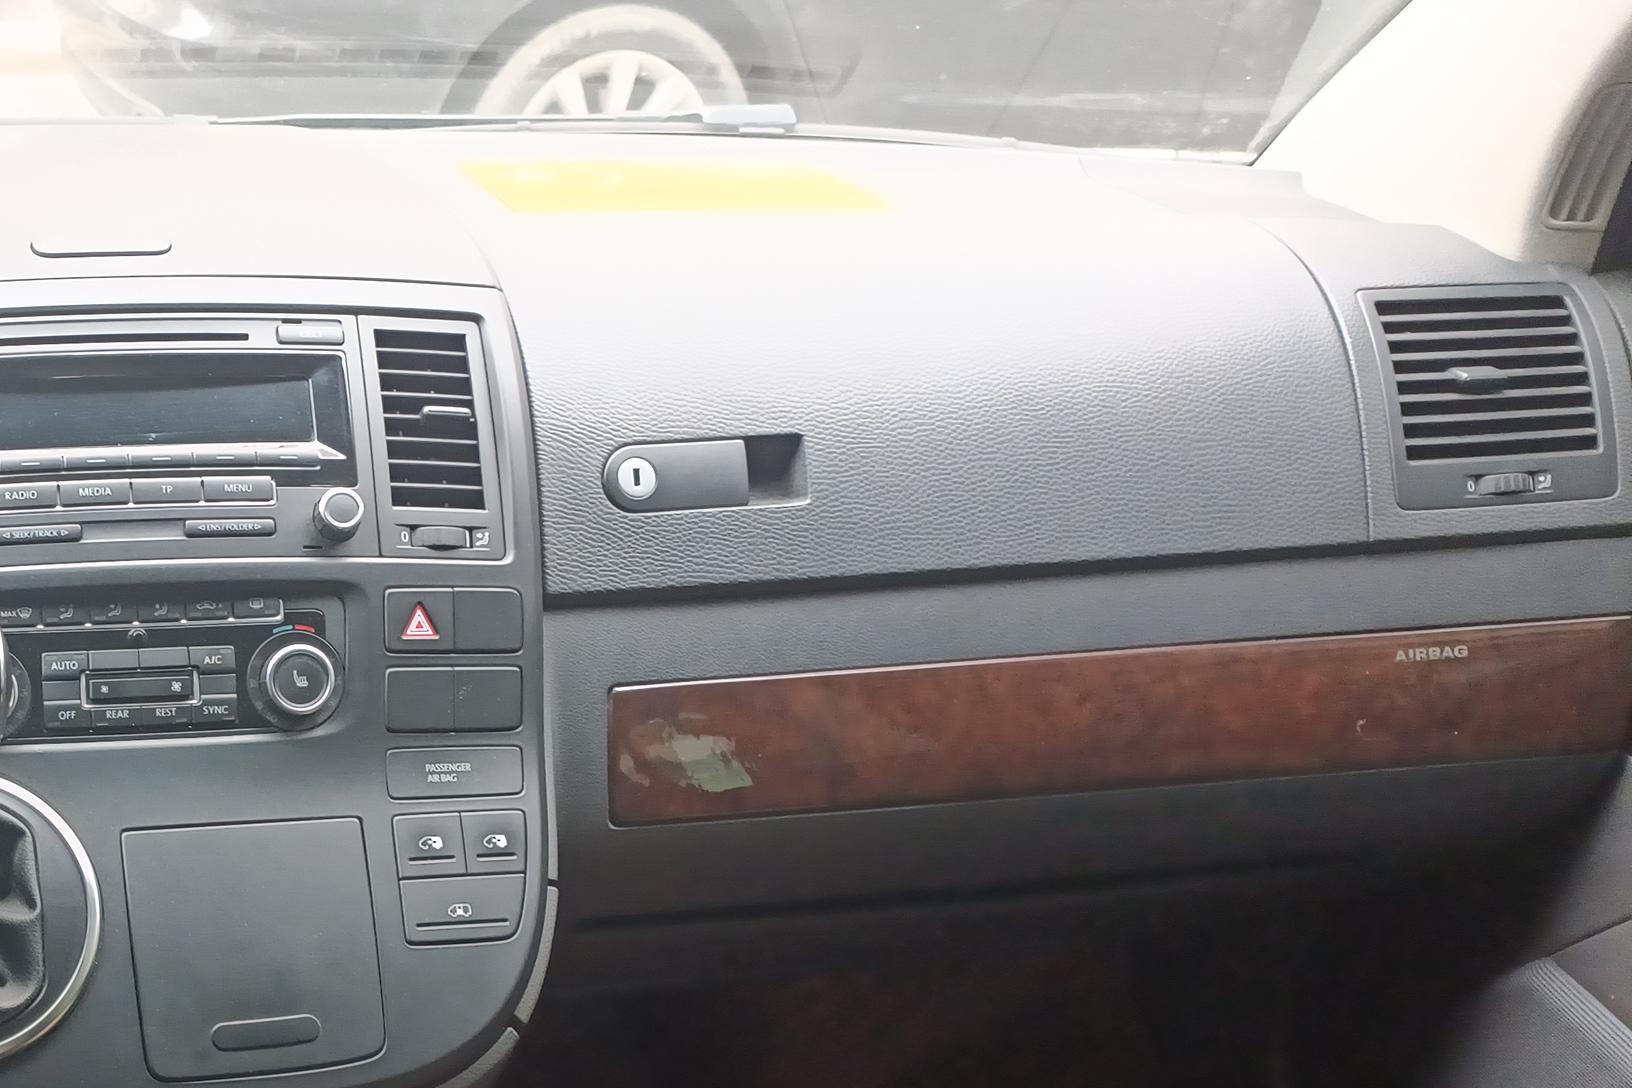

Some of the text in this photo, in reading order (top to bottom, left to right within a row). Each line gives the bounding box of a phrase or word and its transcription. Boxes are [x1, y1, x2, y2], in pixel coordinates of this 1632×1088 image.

[78, 486, 112, 497] MEDIA
[161, 485, 173, 495] TP
[225, 483, 253, 493] MENU
[4, 490, 38, 500] RADIO
[11, 529, 58, 539] SEEK/TRACK
[0, 610, 17, 618] MAX
[1395, 645, 1469, 663] AIRBAG
[203, 654, 223, 665] A/C
[50, 660, 79, 672] AUTO
[105, 710, 130, 720] REAR
[155, 707, 177, 718] REST
[202, 704, 229, 716] SYNC
[58, 710, 77, 721] OFF
[425, 762, 472, 772] PASSENGER
